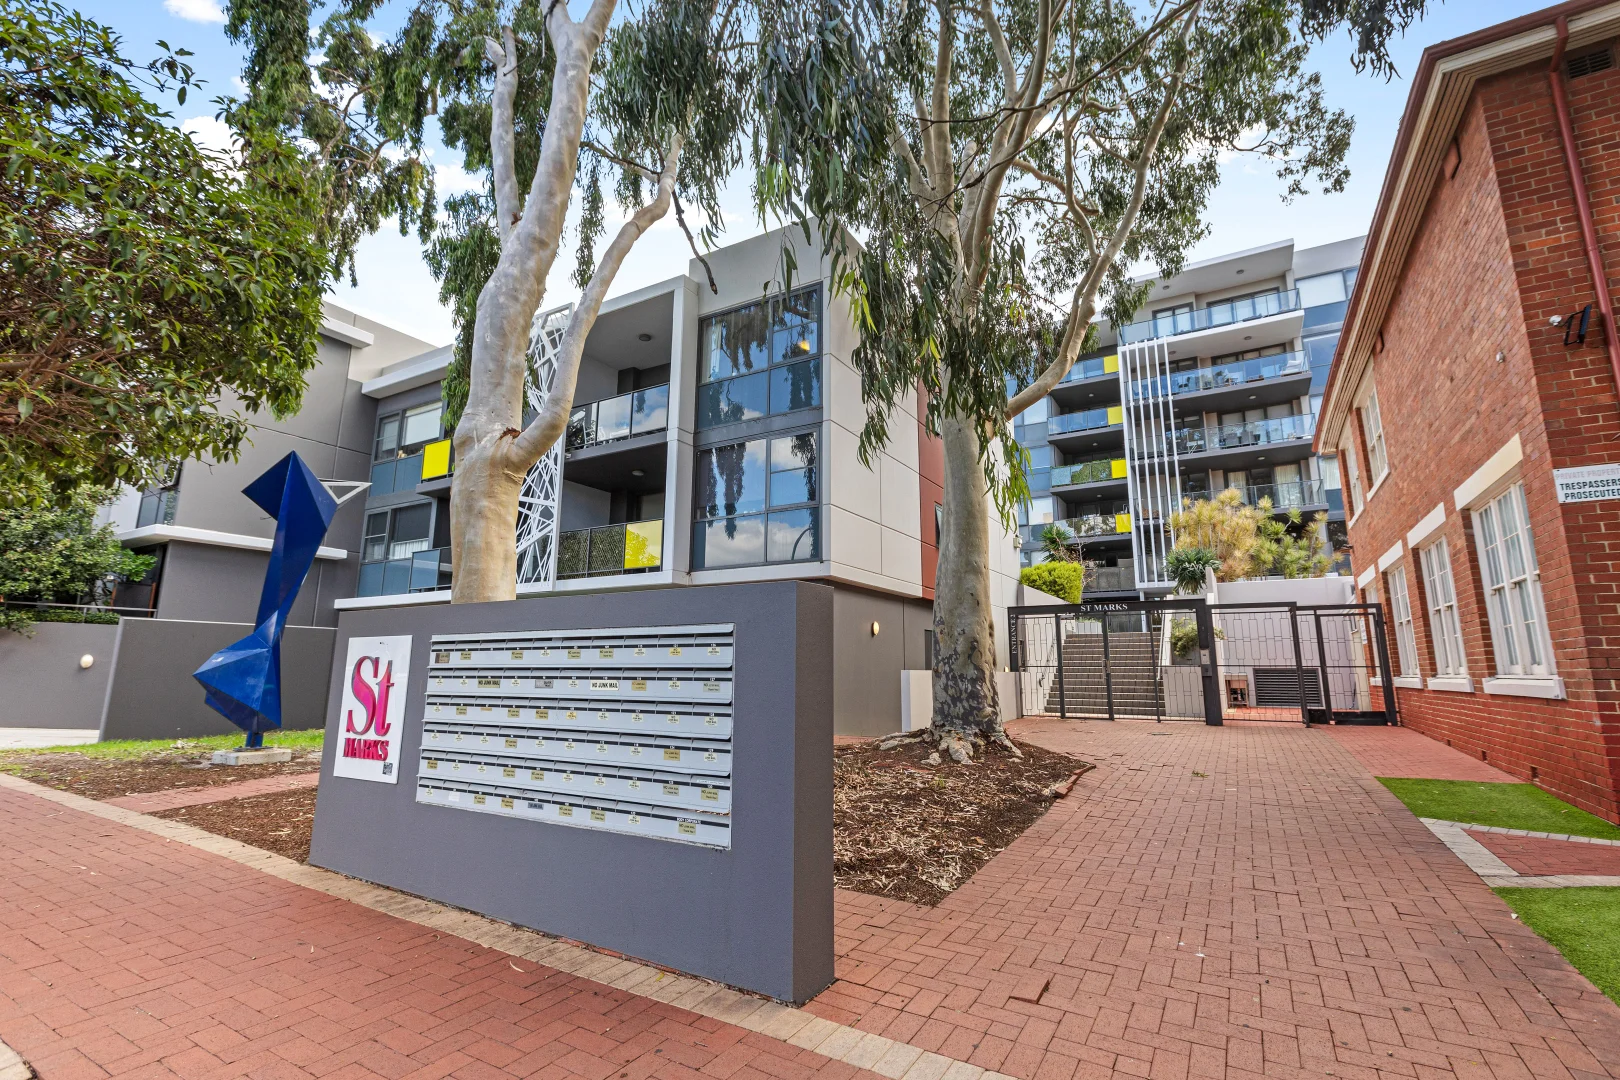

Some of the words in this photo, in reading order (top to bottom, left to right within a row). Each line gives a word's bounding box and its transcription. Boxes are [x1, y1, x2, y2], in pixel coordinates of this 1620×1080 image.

[1555, 471, 1584, 480] PRIVATE
[1564, 488, 1620, 500] PROSECUTED
[1093, 603, 1128, 612] MARKS
[346, 656, 394, 736] St
[342, 738, 390, 762] MARKS
